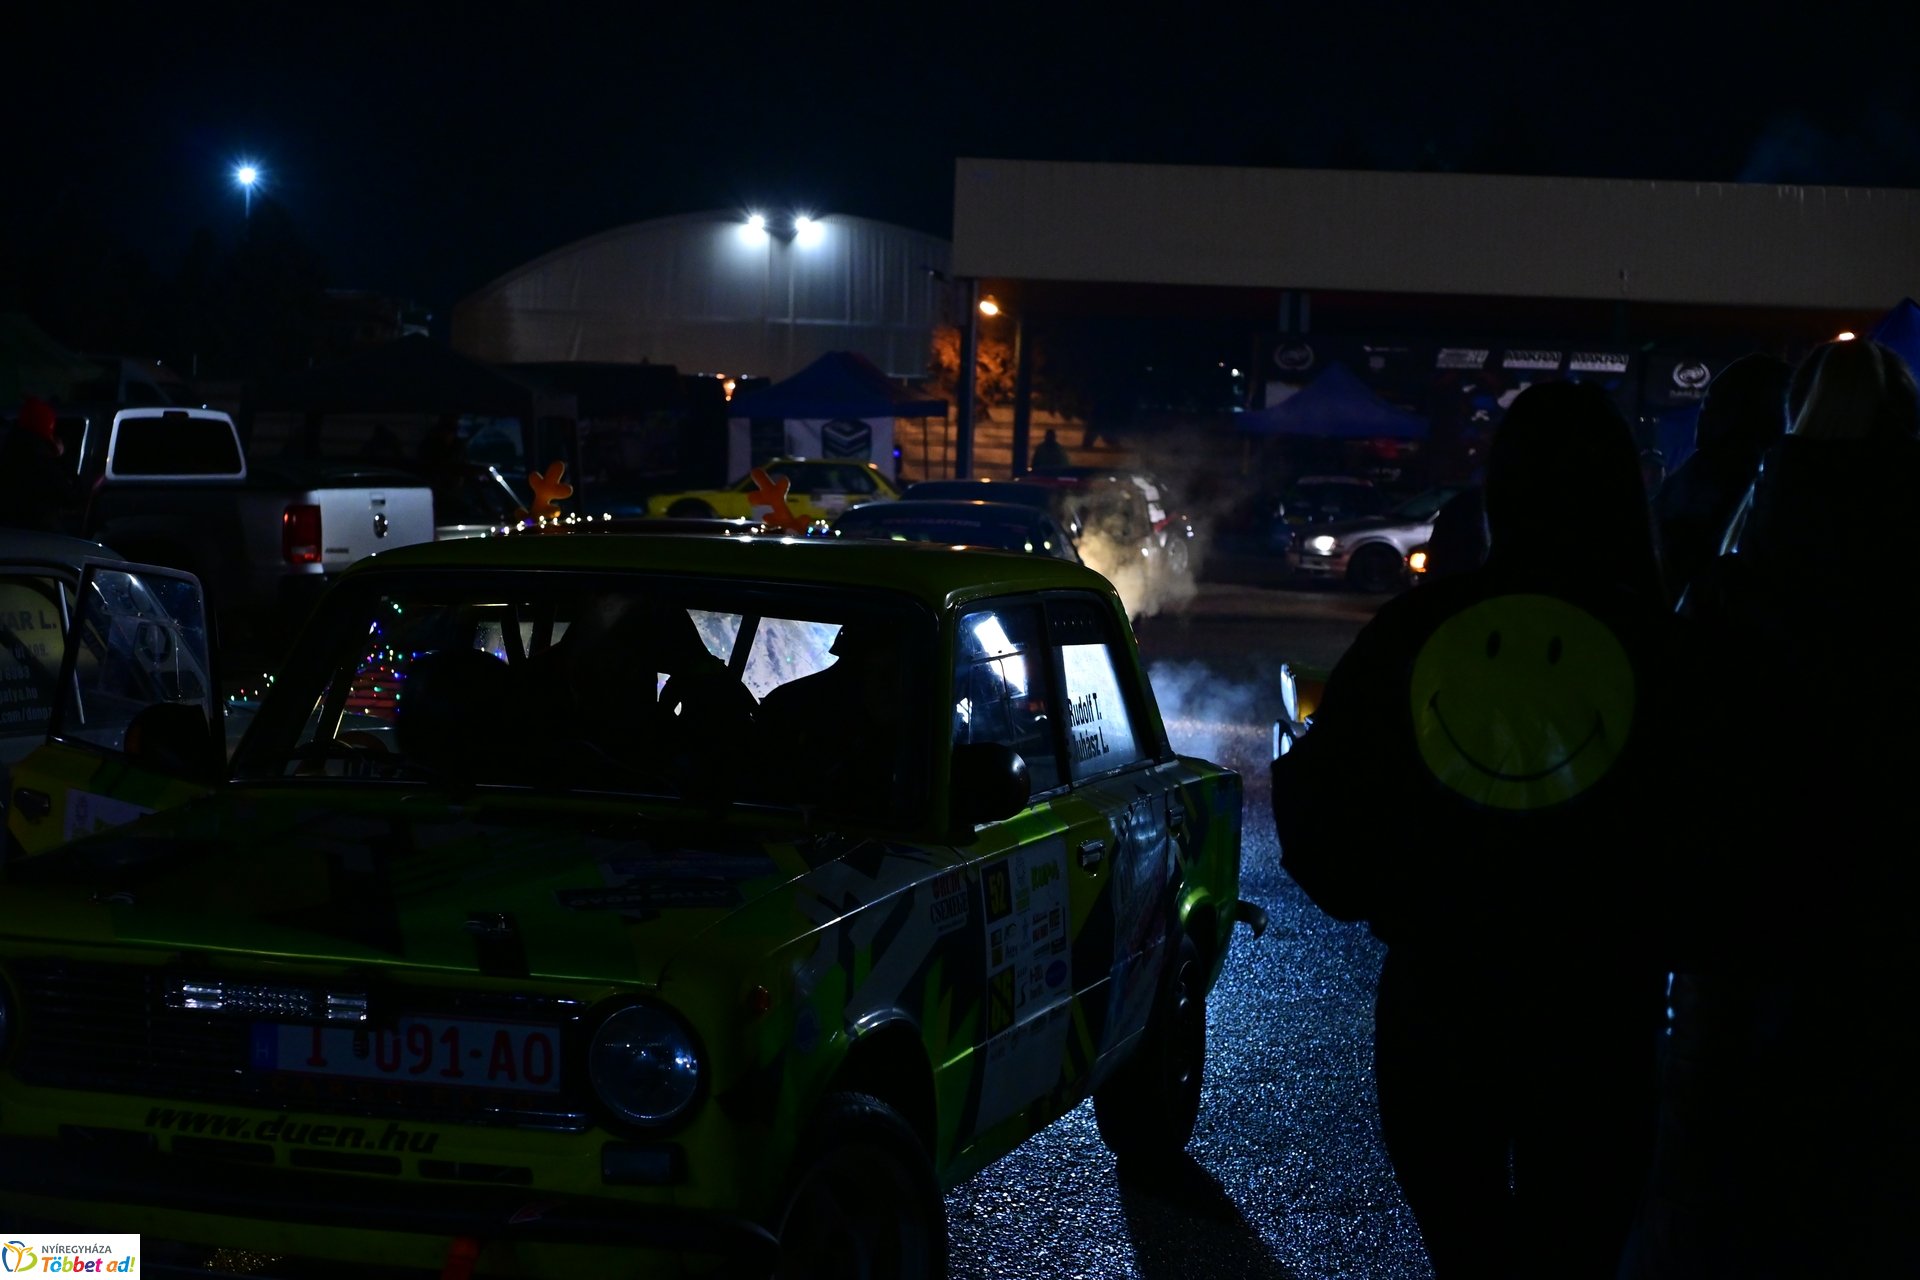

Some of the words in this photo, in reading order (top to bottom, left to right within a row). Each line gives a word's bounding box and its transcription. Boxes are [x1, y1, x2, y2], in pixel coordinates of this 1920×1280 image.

[1067, 694, 1094, 727] Rudolf
[987, 869, 1008, 915] 52
[144, 1106, 440, 1154] www.duen.hu
